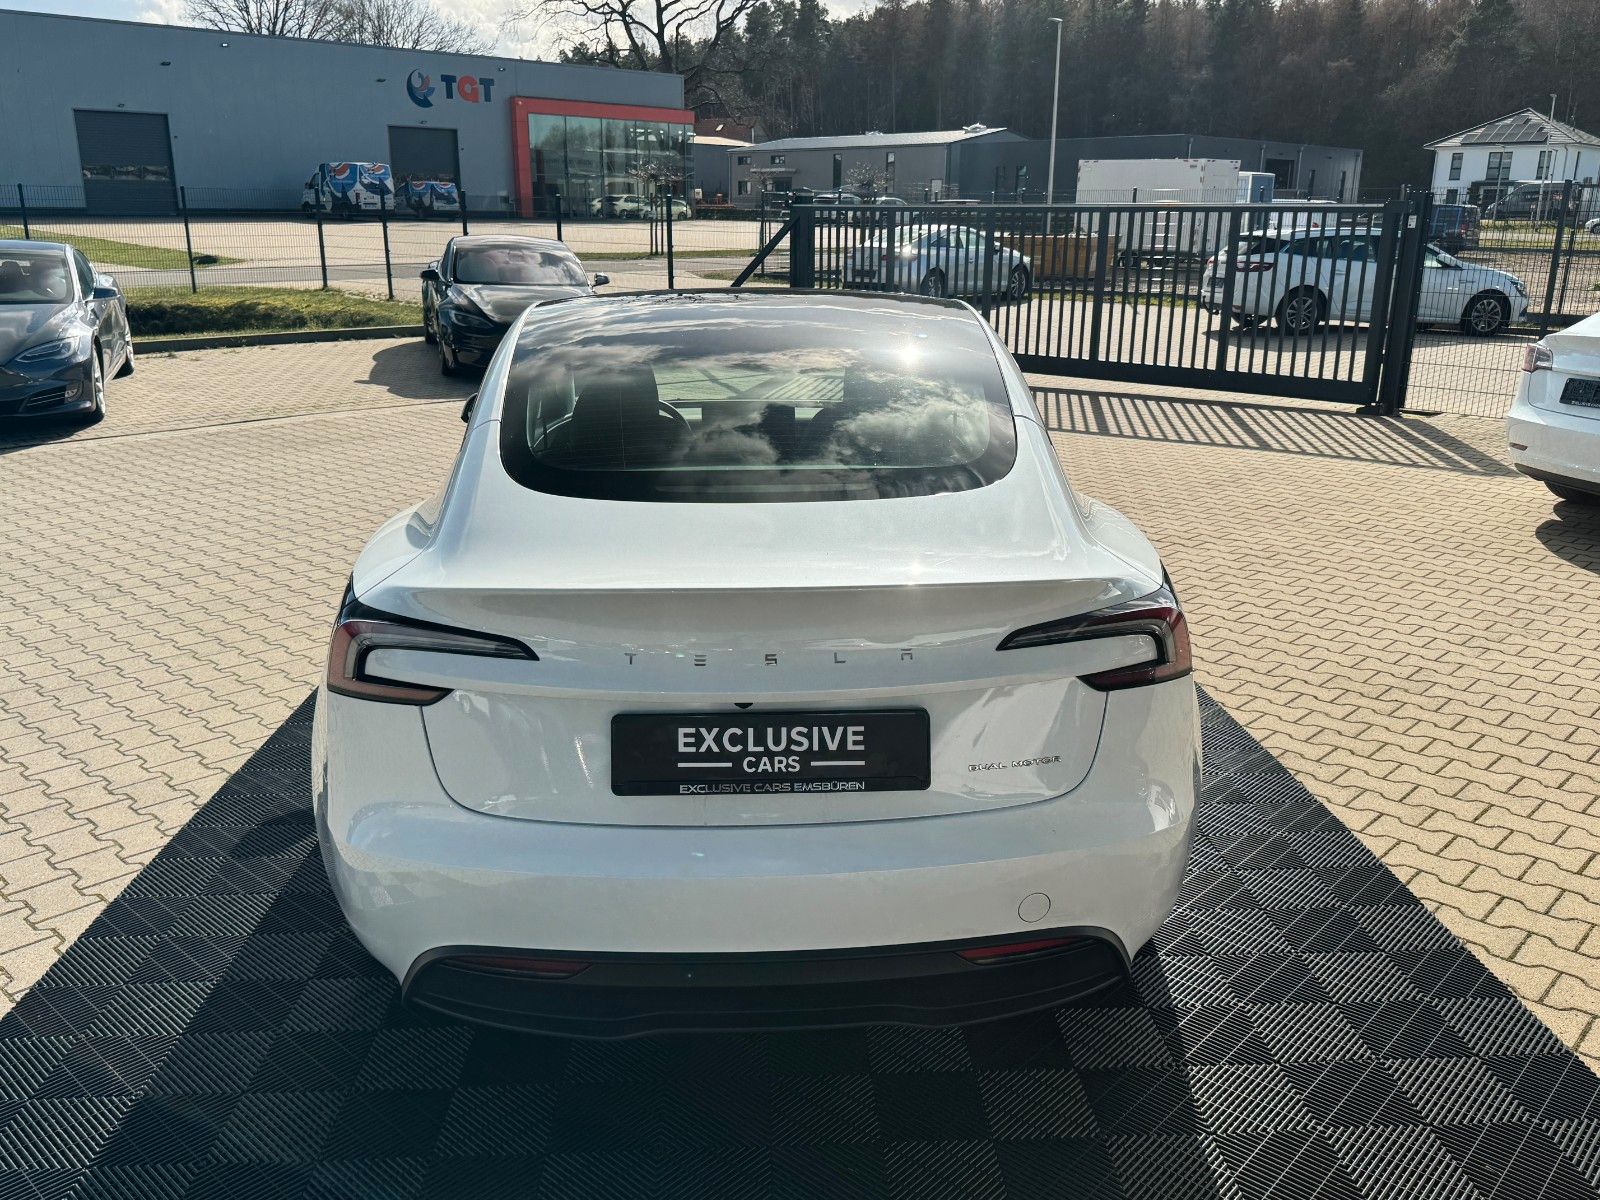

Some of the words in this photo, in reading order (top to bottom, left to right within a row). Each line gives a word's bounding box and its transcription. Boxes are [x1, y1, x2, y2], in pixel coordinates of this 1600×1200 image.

[440, 74, 495, 103] TGT
[624, 648, 914, 667] TESLA
[677, 725, 865, 752] EXCLUSIVE
[743, 756, 801, 773] CARS
[968, 762, 1007, 772] DUAL
[1011, 755, 1062, 768] MOTOR
[679, 783, 751, 794] EXCLUSIVE
[753, 782, 791, 793] CARS
[793, 780, 865, 793] EMSBÜREN
